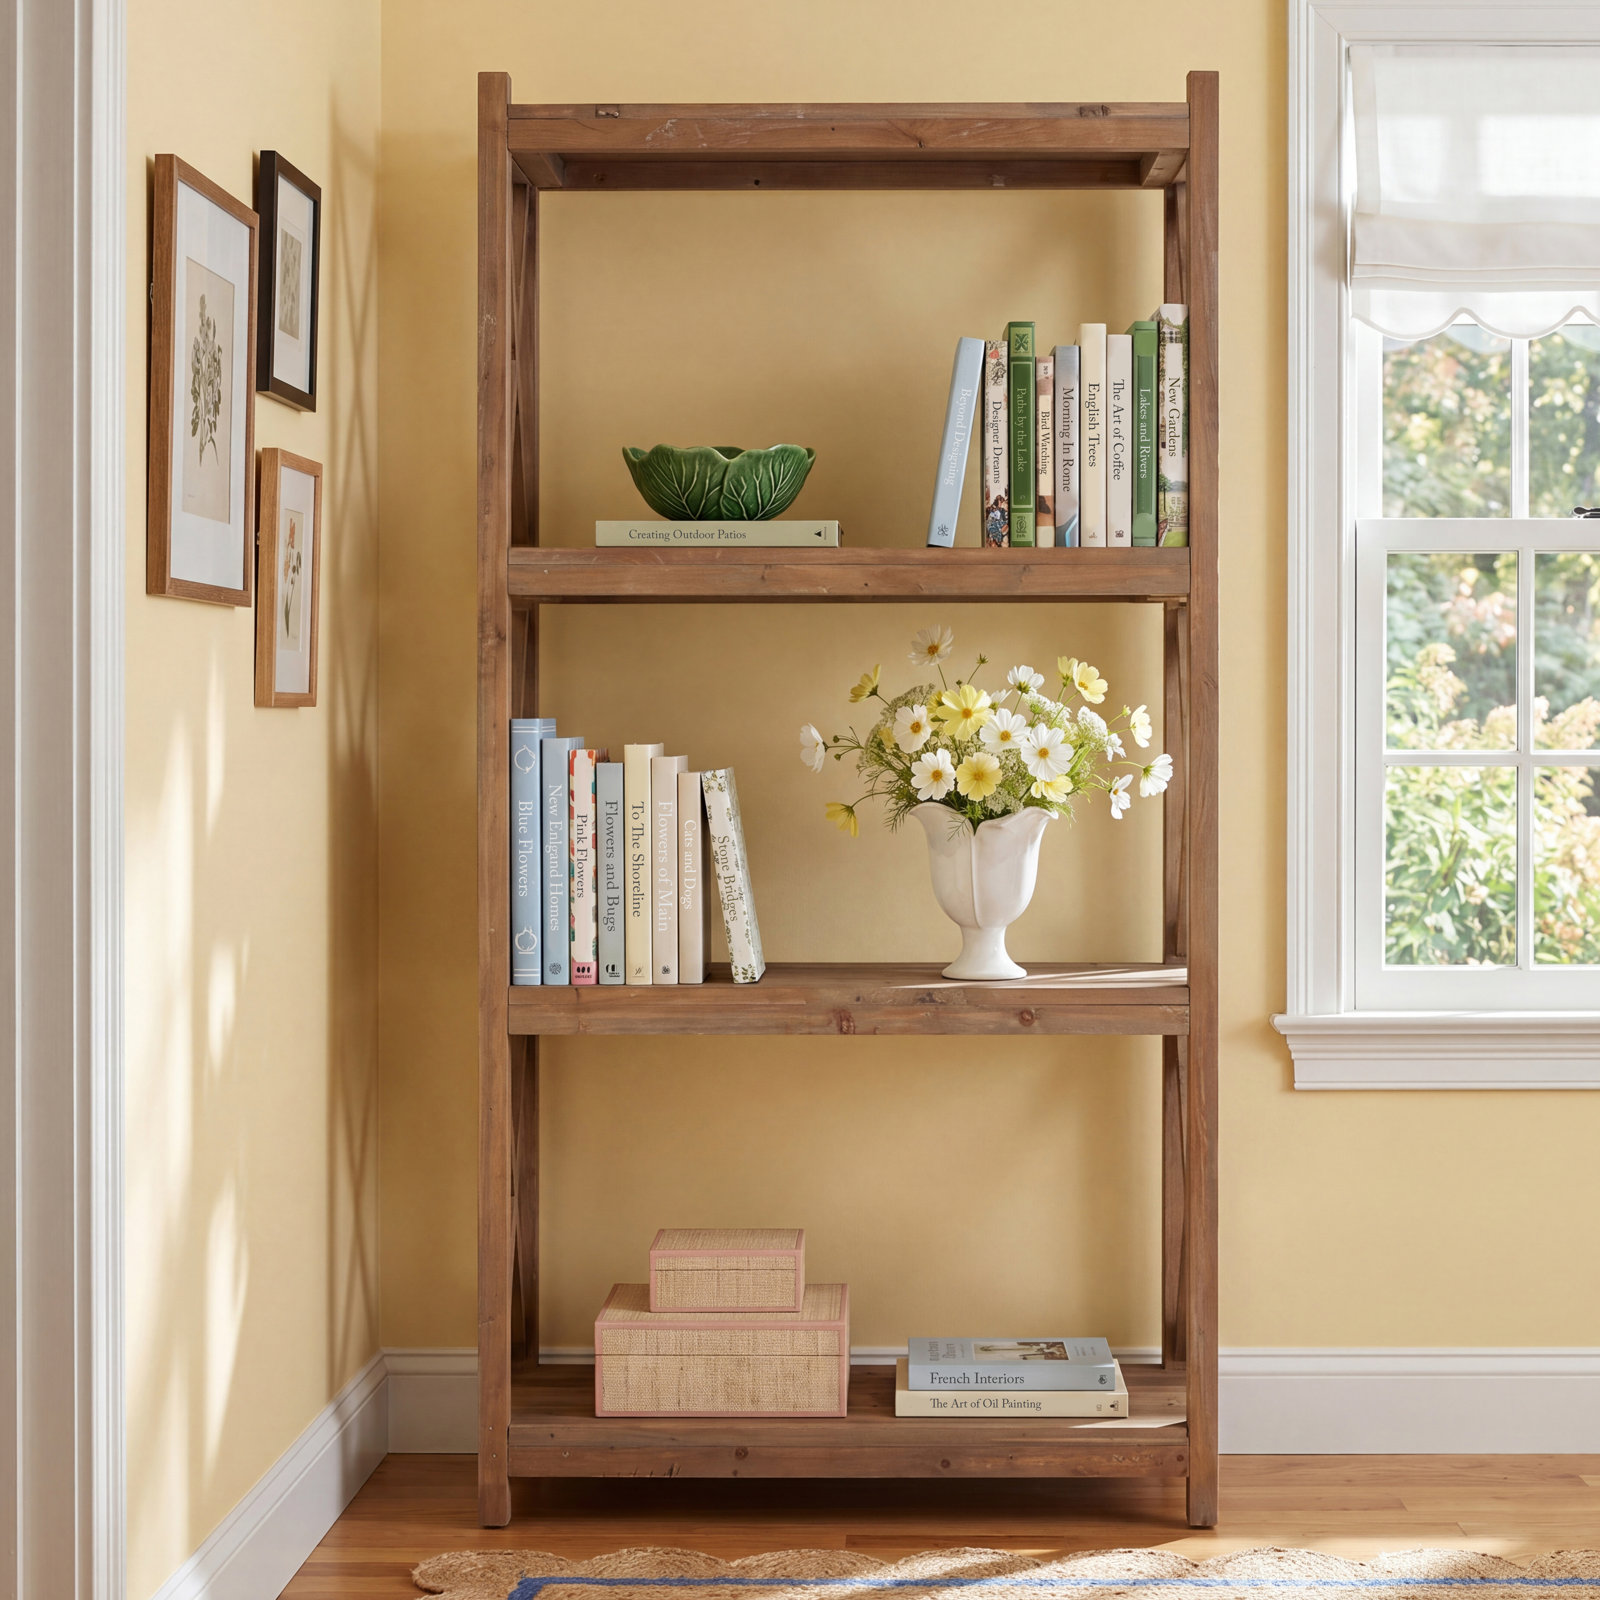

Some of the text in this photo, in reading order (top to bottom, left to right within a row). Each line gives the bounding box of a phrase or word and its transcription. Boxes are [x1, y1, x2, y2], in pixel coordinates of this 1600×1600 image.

[944, 388, 972, 486] Beyond Designing
[990, 401, 1003, 484] Designer Dreams
[1014, 388, 1027, 472] Paths by the Lake
[1039, 411, 1051, 475] Bird Watching
[1059, 388, 1075, 492] Morning In Rome
[1085, 383, 1100, 467] English Trees
[1113, 379, 1125, 481] The Art of Coffee
[1140, 388, 1151, 479] Lakes and Rivers
[1168, 377, 1181, 457] New Gardens
[629, 529, 746, 541] Creating Outdoor Patios
[518, 800, 533, 897] Blue Flowers
[545, 785, 563, 931] New Enlgand Homes
[577, 814, 588, 898] Pink Flowers
[603, 801, 620, 932] Flowers and Bugs
[632, 801, 645, 917] To The Shoreline
[658, 801, 673, 931] Flowers of Main
[680, 820, 697, 910] Cats and Dogs
[717, 835, 739, 922] Stone Bridges
[930, 1372, 1025, 1384] French Interiors
[930, 1398, 1042, 1410] The Art of Oil Painting
